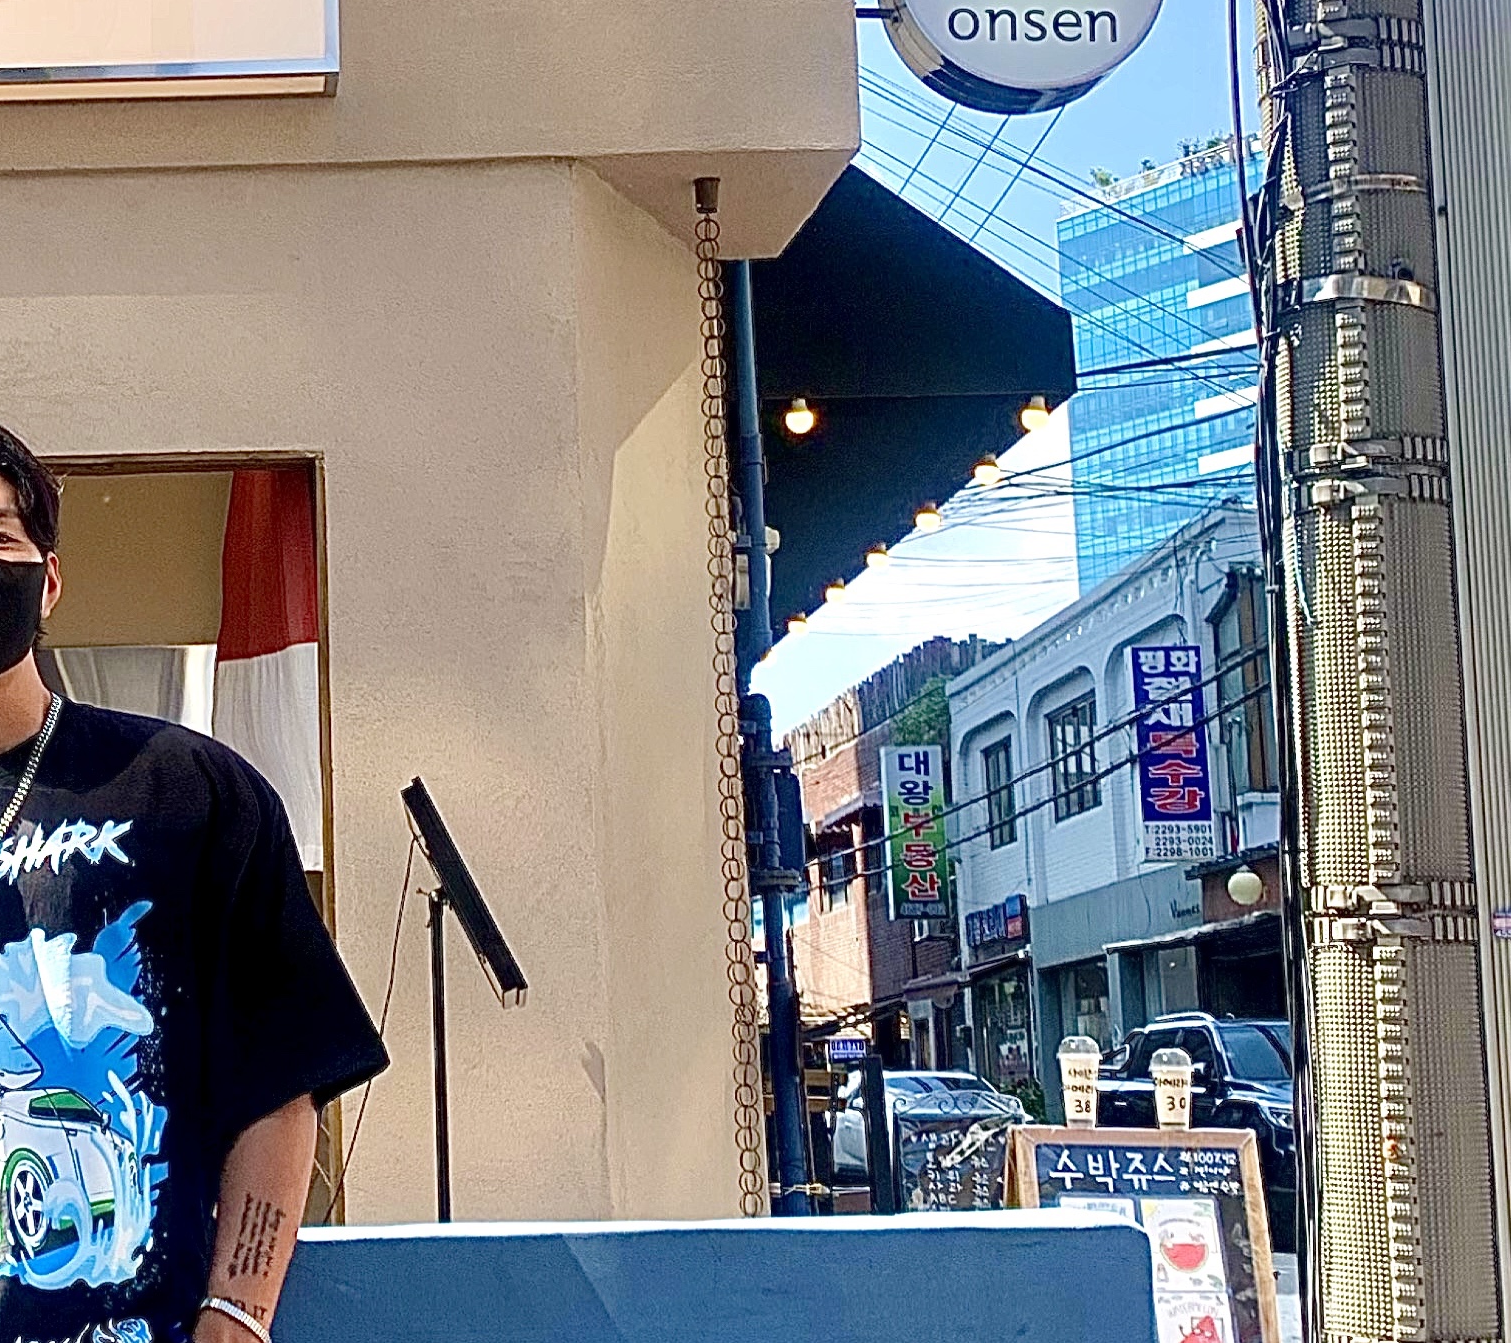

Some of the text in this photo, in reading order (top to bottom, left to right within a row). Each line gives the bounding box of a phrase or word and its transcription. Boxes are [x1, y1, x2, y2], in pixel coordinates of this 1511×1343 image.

[948, 8, 1117, 42] onsen
[898, 751, 933, 806] 대왕
[900, 812, 942, 901] 부동산
[1049, 1149, 1176, 1193] 수박쥬스
